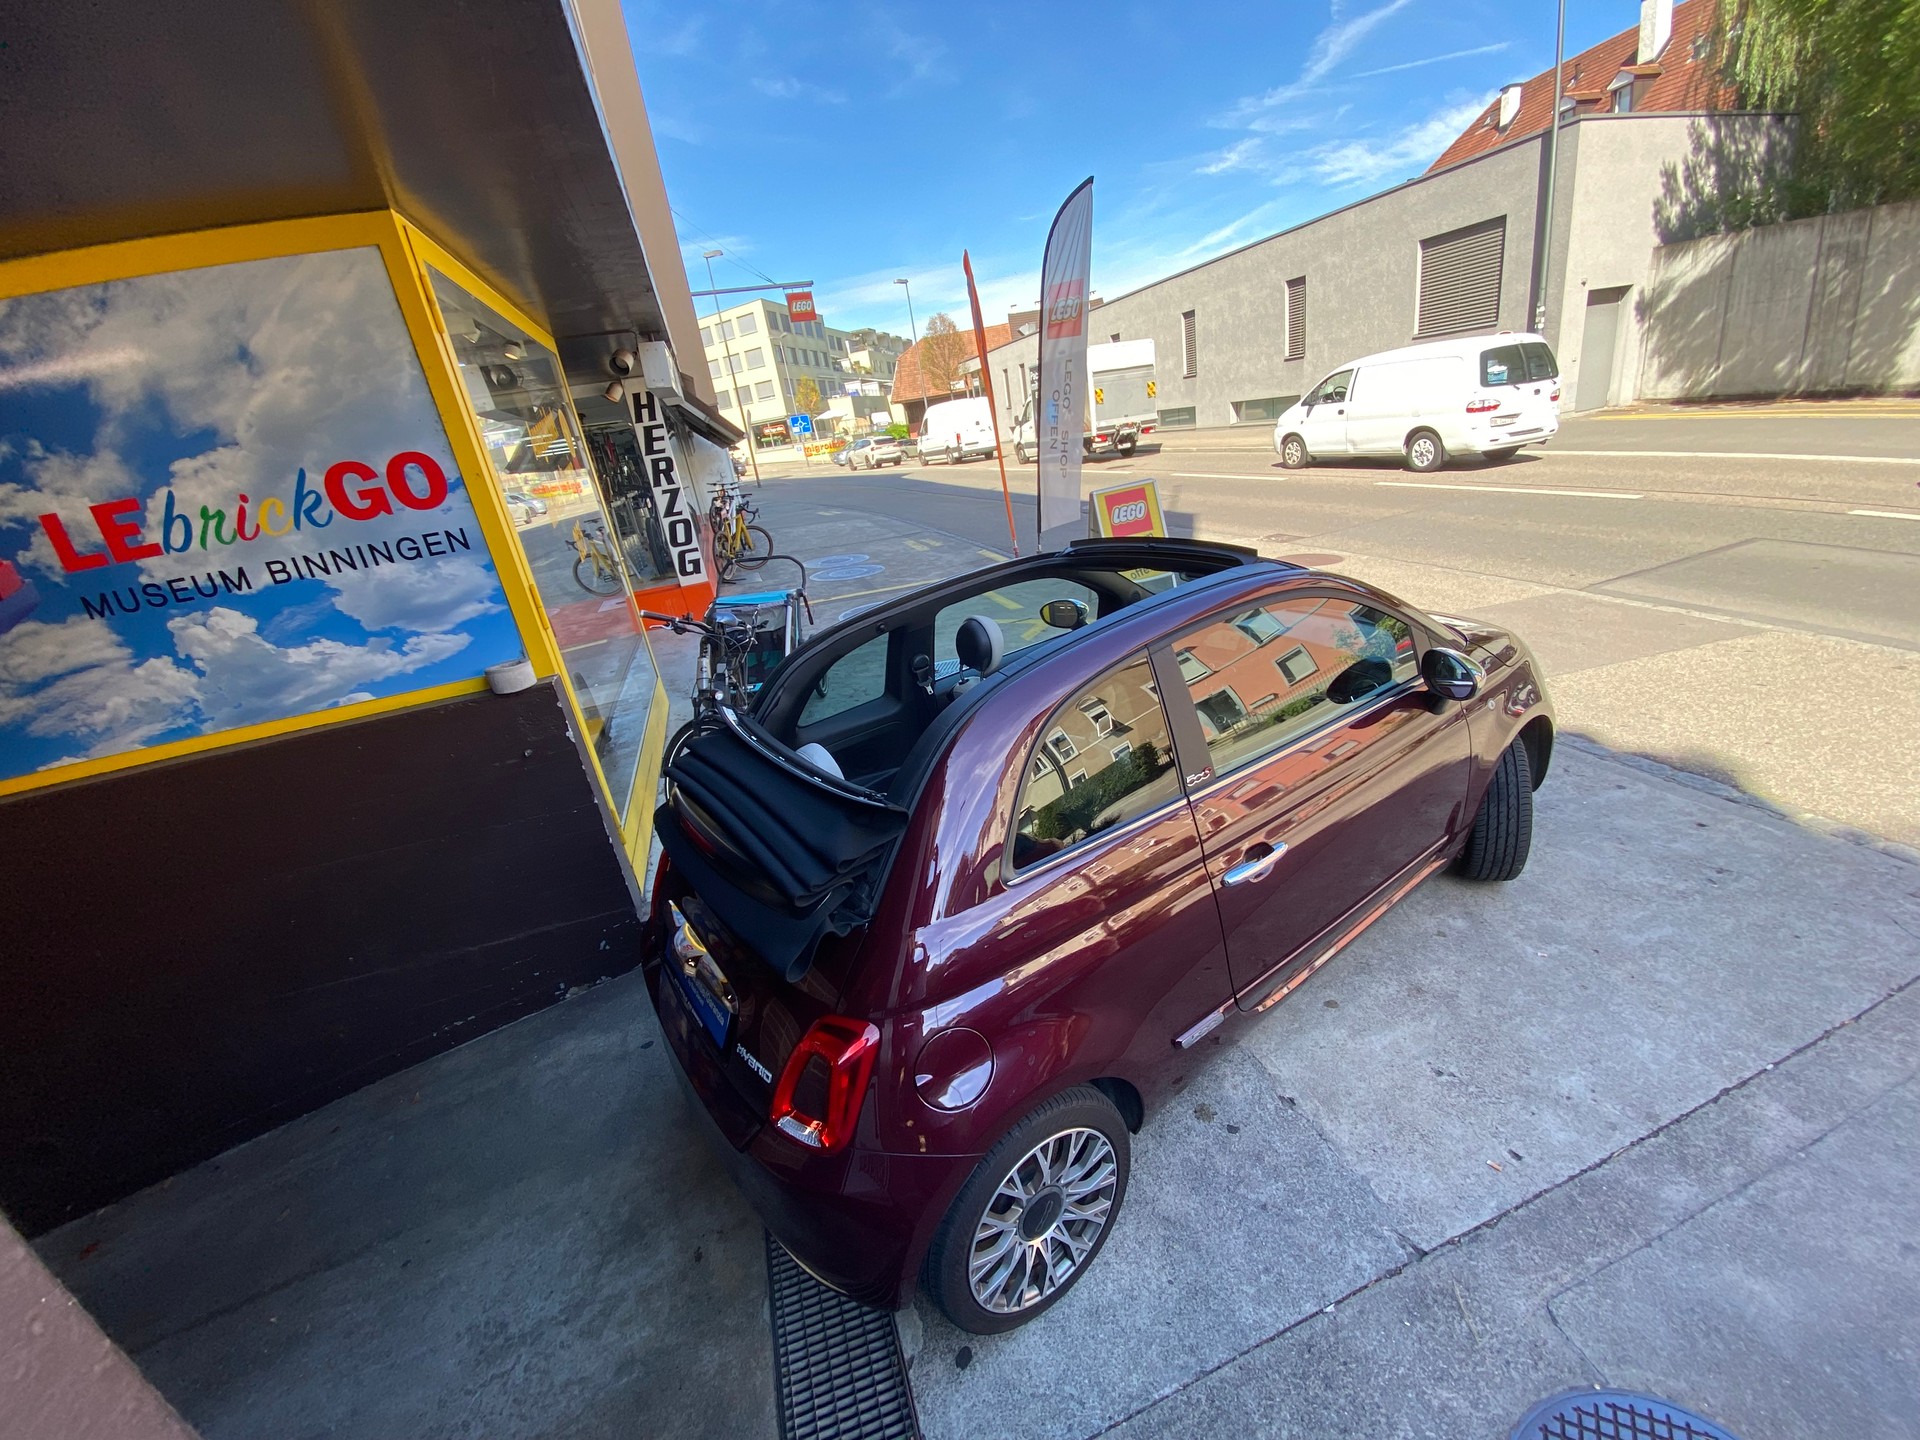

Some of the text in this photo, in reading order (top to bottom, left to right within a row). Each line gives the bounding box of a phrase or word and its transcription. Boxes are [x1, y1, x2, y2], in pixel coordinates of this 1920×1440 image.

[792, 300, 812, 312] LEGO
[1051, 297, 1080, 322] LEGO
[1050, 389, 1060, 450] OFFEN
[1060, 359, 1072, 478] LEGO SHOP
[38, 451, 449, 573] LEbrickGO
[632, 391, 702, 577] HERZOG
[1111, 501, 1147, 525] LEGO
[80, 527, 471, 620] MUSEUM BINNINGEN
